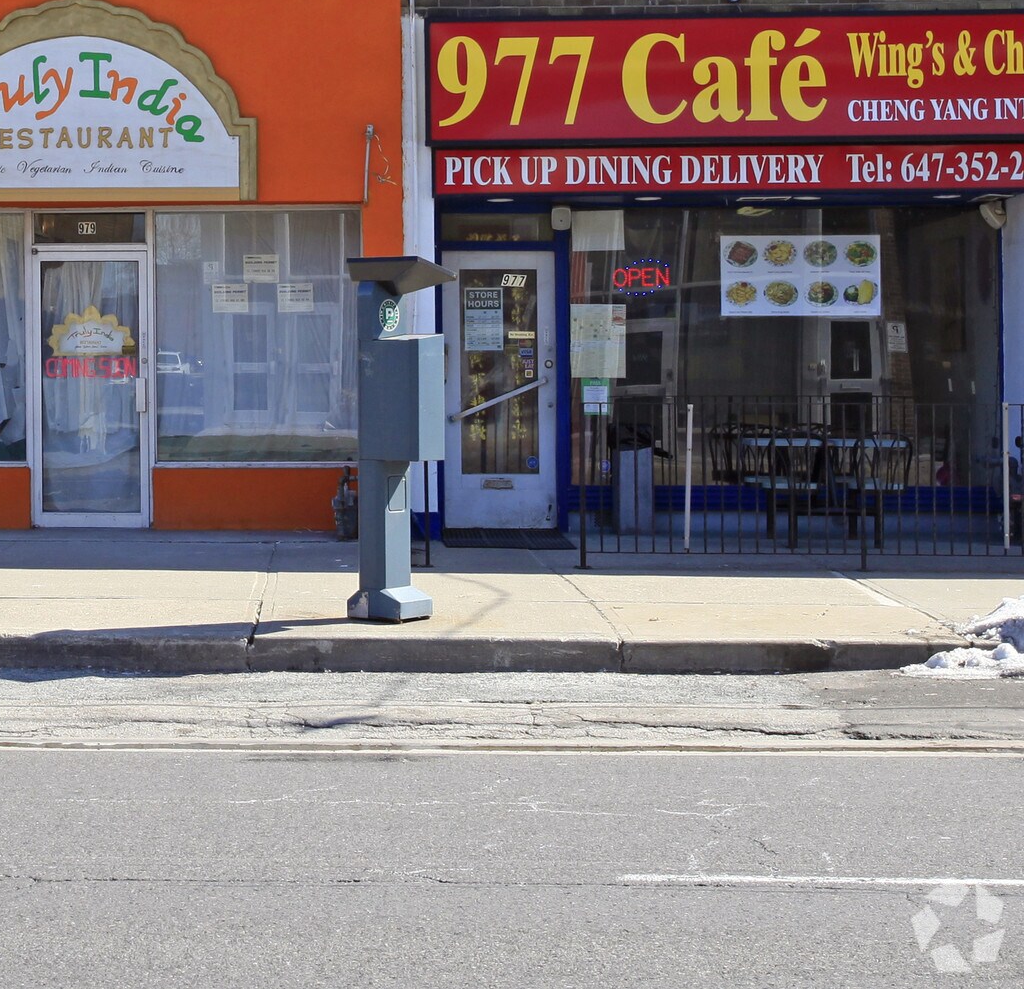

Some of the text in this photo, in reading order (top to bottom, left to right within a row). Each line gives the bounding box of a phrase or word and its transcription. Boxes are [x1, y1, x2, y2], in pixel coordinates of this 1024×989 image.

[846, 30, 946, 89] Wing's
[953, 30, 976, 76] &
[437, 27, 828, 127] 977 Café
[78, 51, 205, 143] India
[847, 99, 926, 122] CHENG
[929, 98, 989, 121] YANG
[16, 159, 73, 177] Vegetarian
[83, 160, 128, 174] Indian
[139, 159, 185, 174] Cuisine
[444, 154, 825, 186] PICK UP DINING DELIVERY
[846, 153, 894, 183] Tel:
[78, 222, 96, 234] 979
[502, 274, 526, 286] 977
[612, 267, 671, 287] OPEN
[467, 300, 499, 308] HOURS
[469, 291, 498, 299] STORE
[45, 357, 138, 379] COMING SOON
